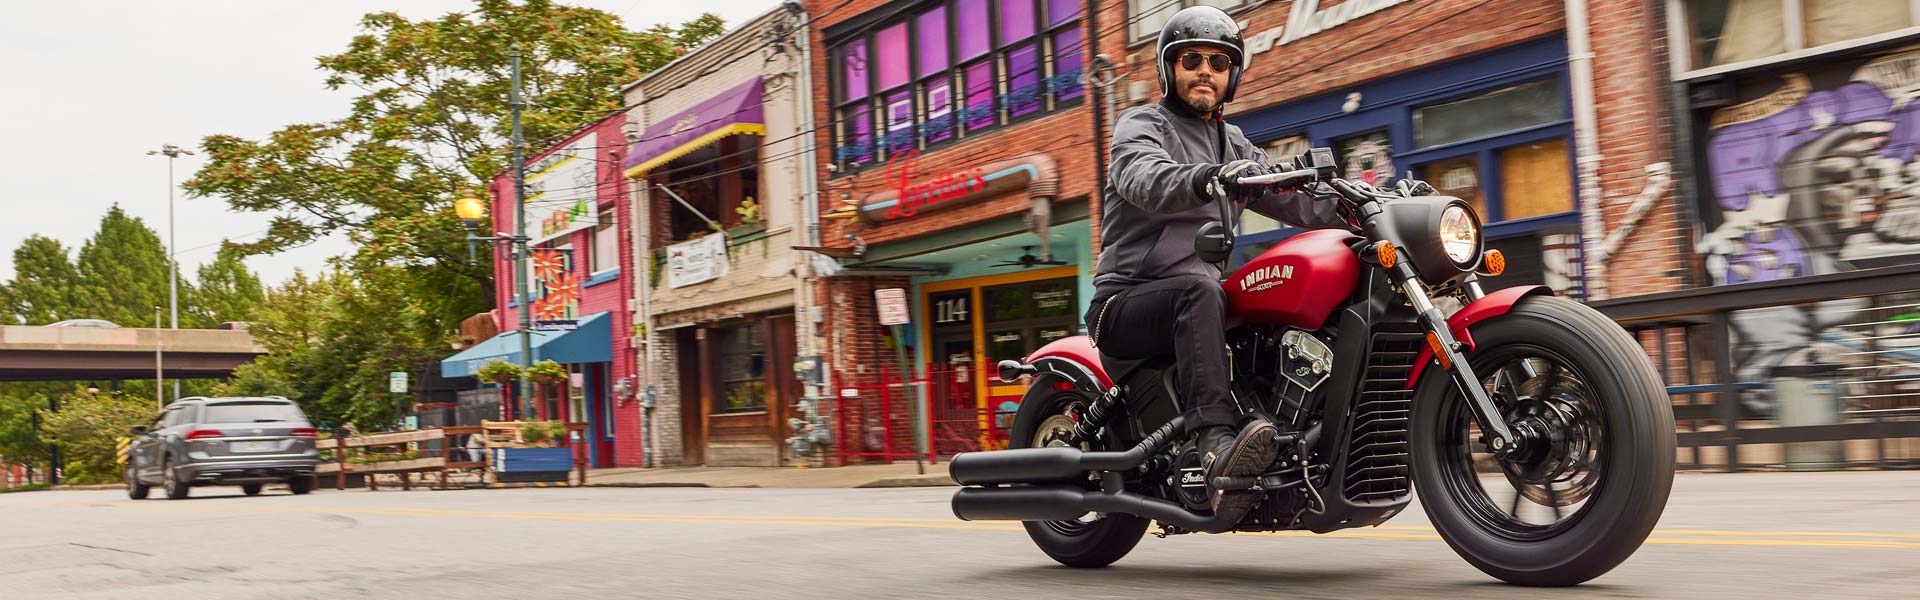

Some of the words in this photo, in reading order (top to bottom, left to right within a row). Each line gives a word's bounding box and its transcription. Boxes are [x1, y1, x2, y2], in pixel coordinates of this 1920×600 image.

[1239, 264, 1295, 292] INDIAN
[936, 297, 969, 323] 114
[1181, 471, 1205, 484] India
